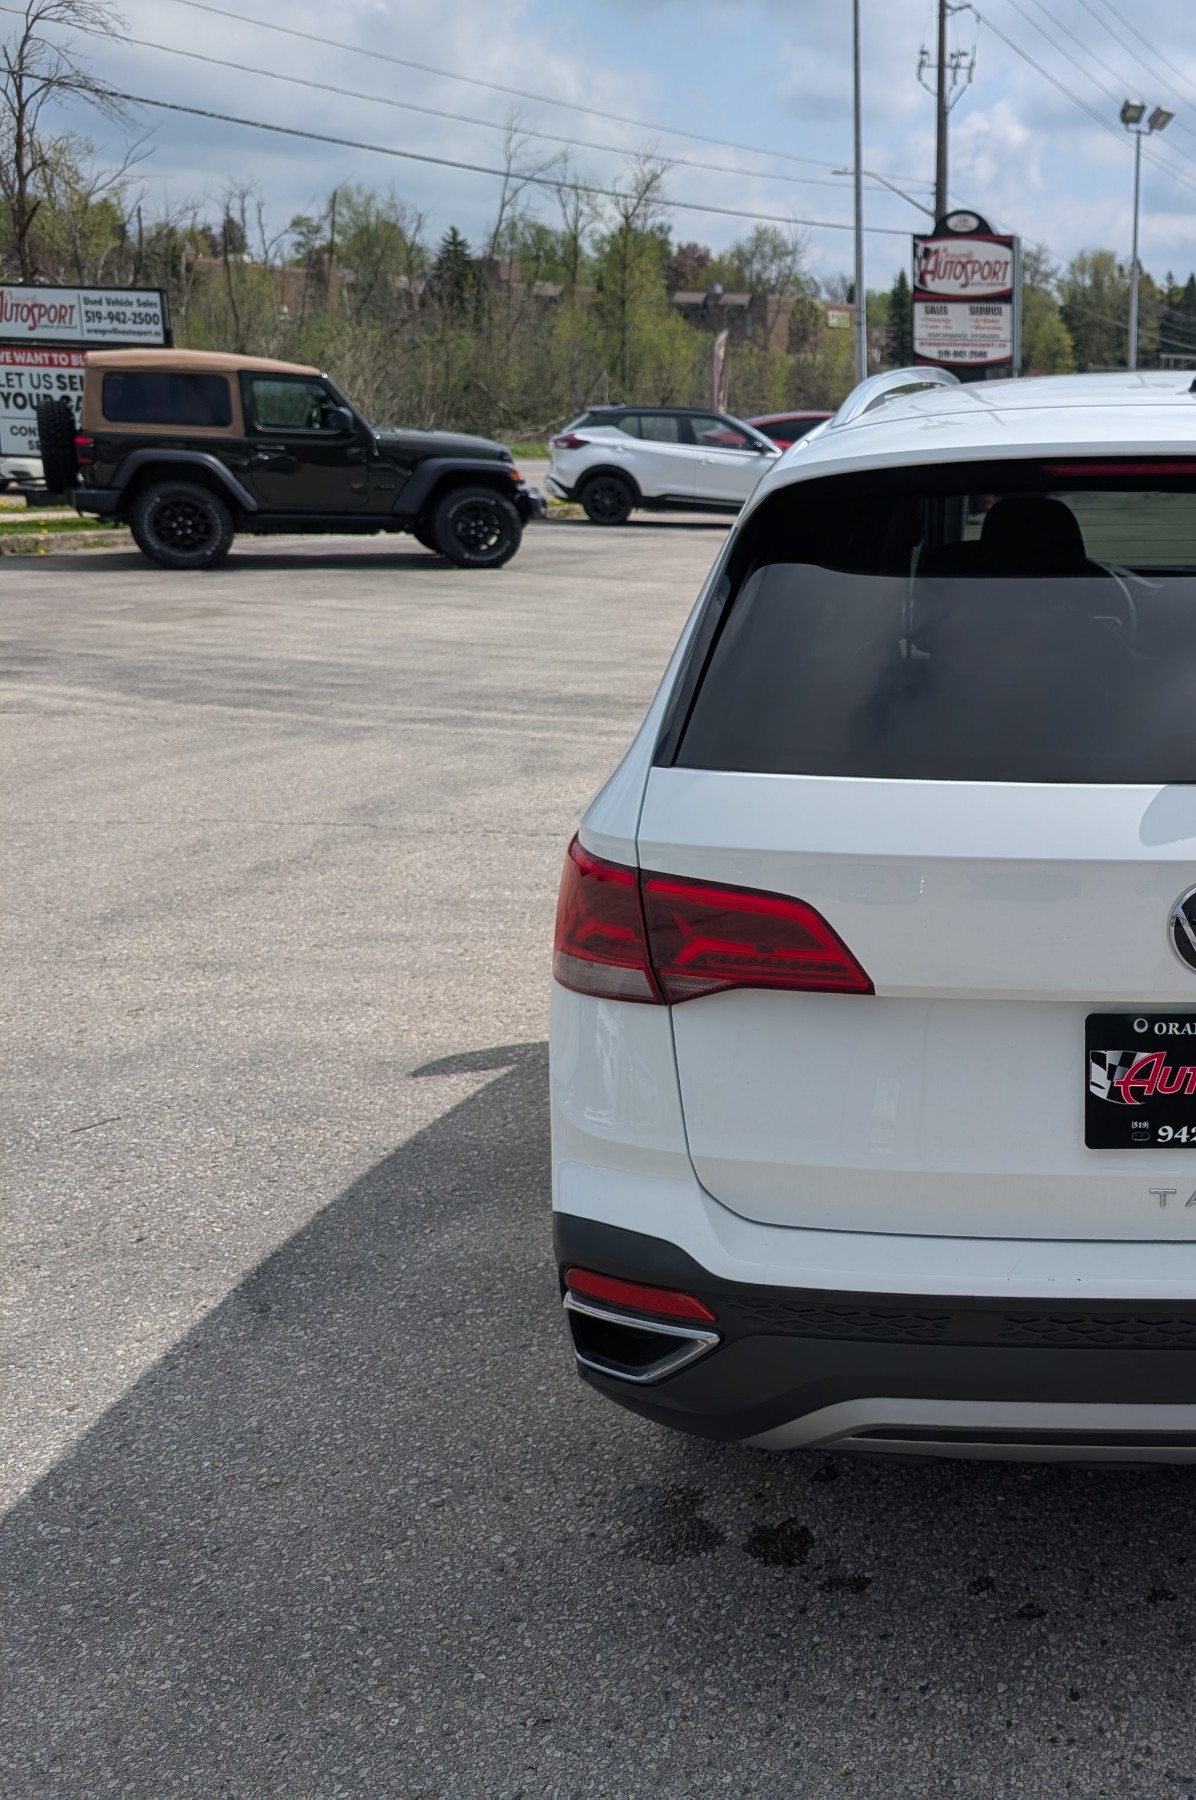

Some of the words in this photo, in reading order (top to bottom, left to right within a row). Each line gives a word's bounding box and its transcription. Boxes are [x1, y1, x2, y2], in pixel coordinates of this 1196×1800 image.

[919, 247, 1011, 289] AUTOSPORT
[83, 296, 103, 307] Used
[106, 297, 134, 308] Vehicle
[136, 298, 158, 309] Sales
[84, 310, 161, 325] 519-942-2500
[13, 352, 50, 364] WANT
[52, 354, 69, 366] TO
[71, 354, 85, 367] BU
[29, 372, 53, 390] US
[56, 374, 84, 391] SE
[1131, 1121, 1149, 1129] (519)
